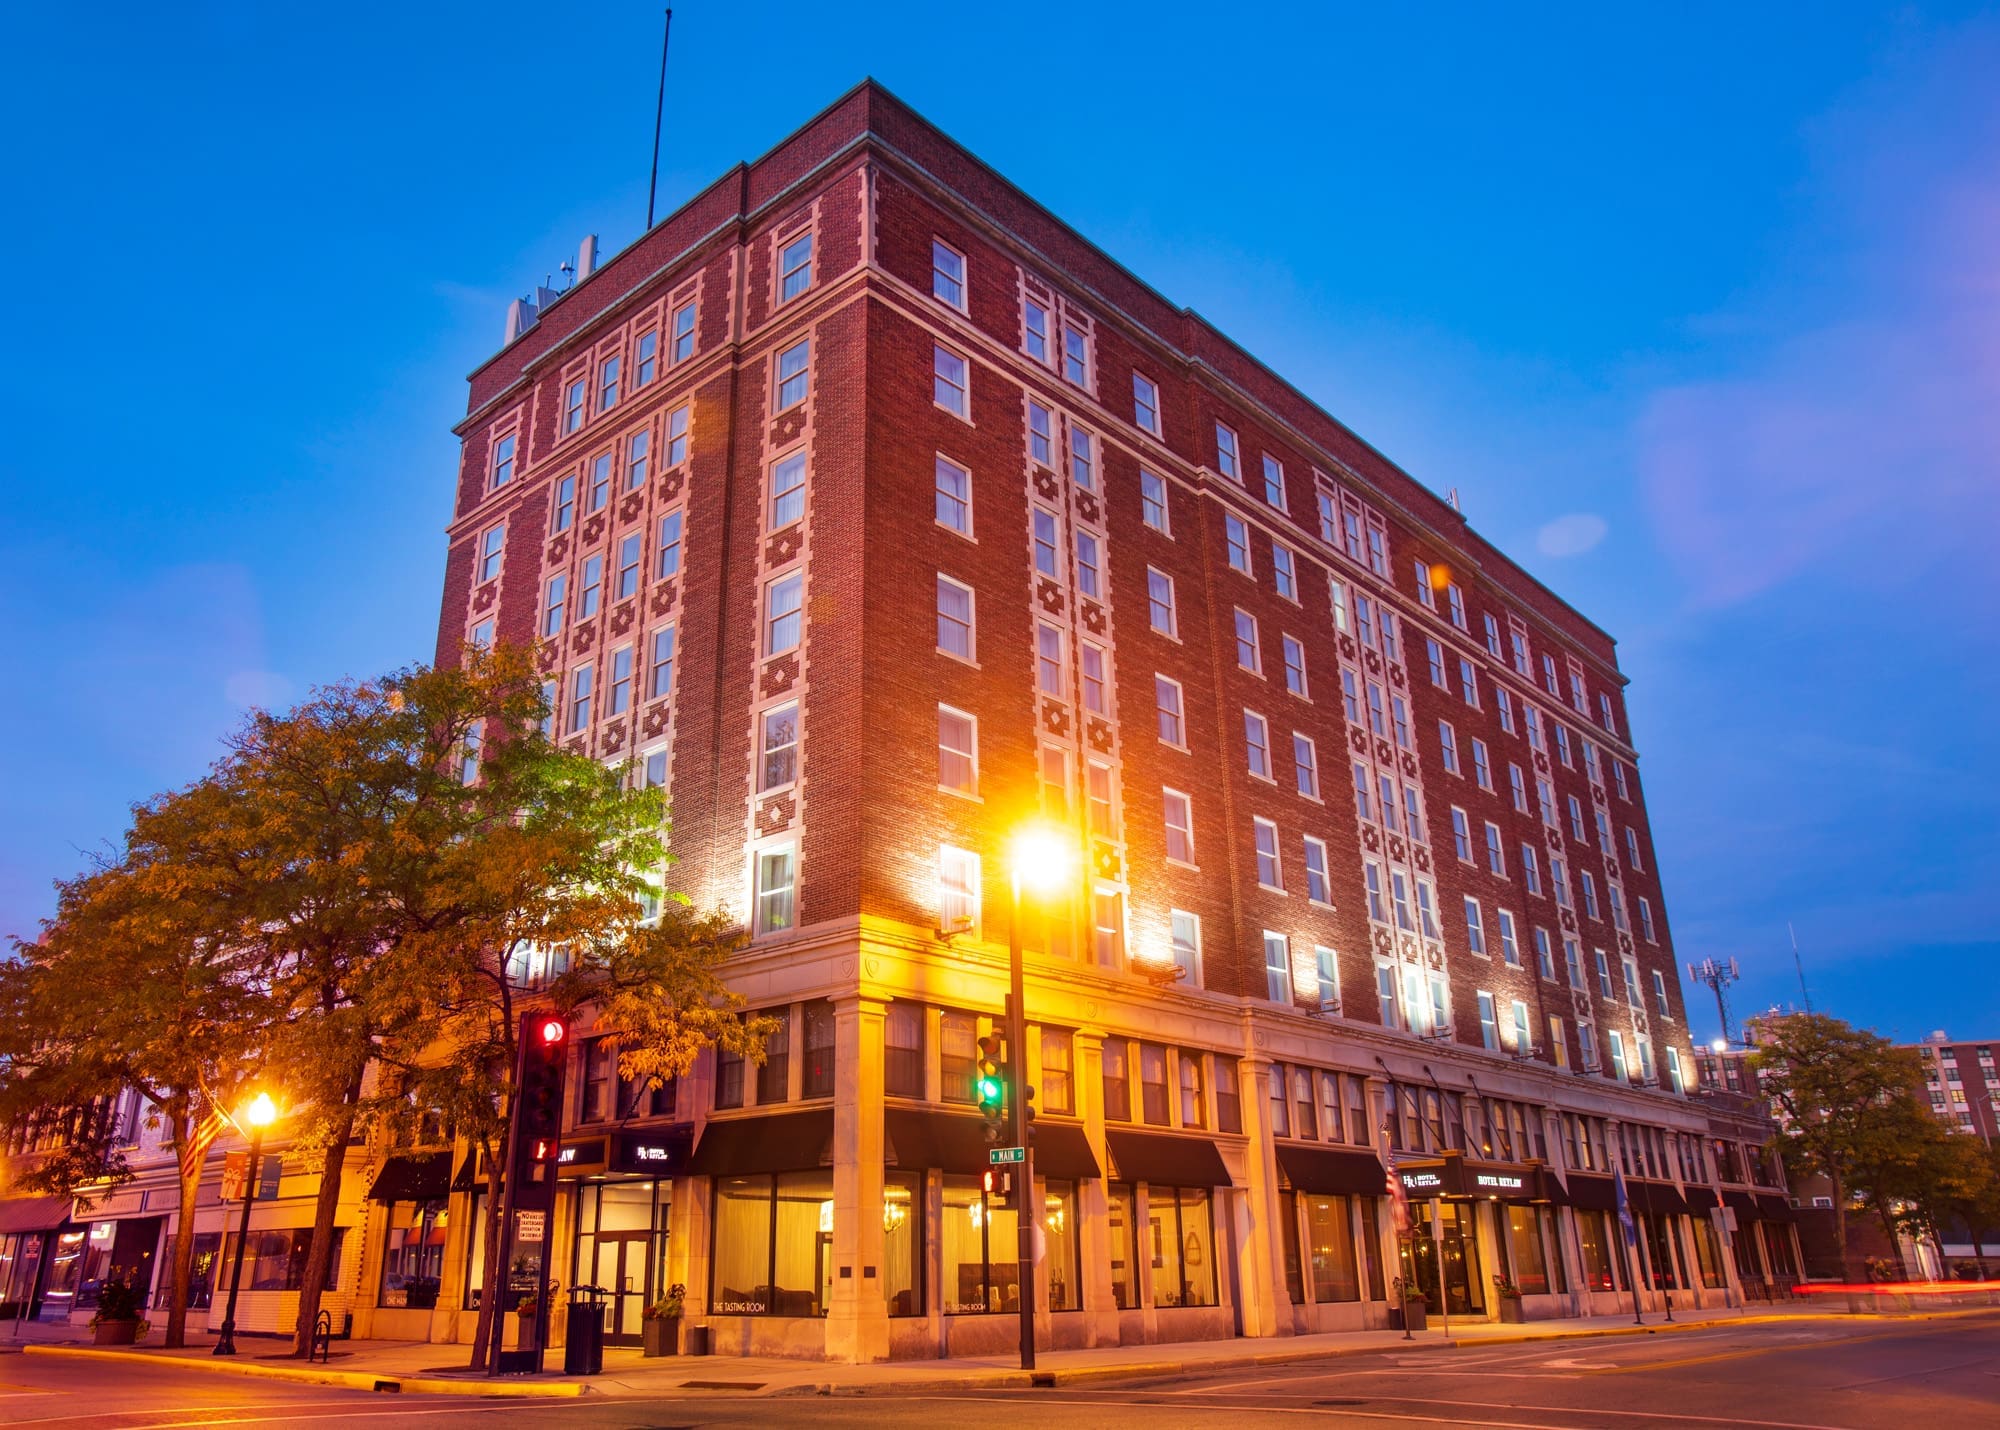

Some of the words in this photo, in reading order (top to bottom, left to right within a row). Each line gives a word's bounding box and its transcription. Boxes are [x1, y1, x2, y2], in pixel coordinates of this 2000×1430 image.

[999, 1150, 1014, 1161] MAIN
[1478, 1175, 1498, 1186] HOTEL
[1499, 1177, 1521, 1188] RETLAW
[713, 1303, 723, 1311] THE
[724, 1303, 745, 1311] TASTING
[746, 1303, 765, 1312] ROOM
